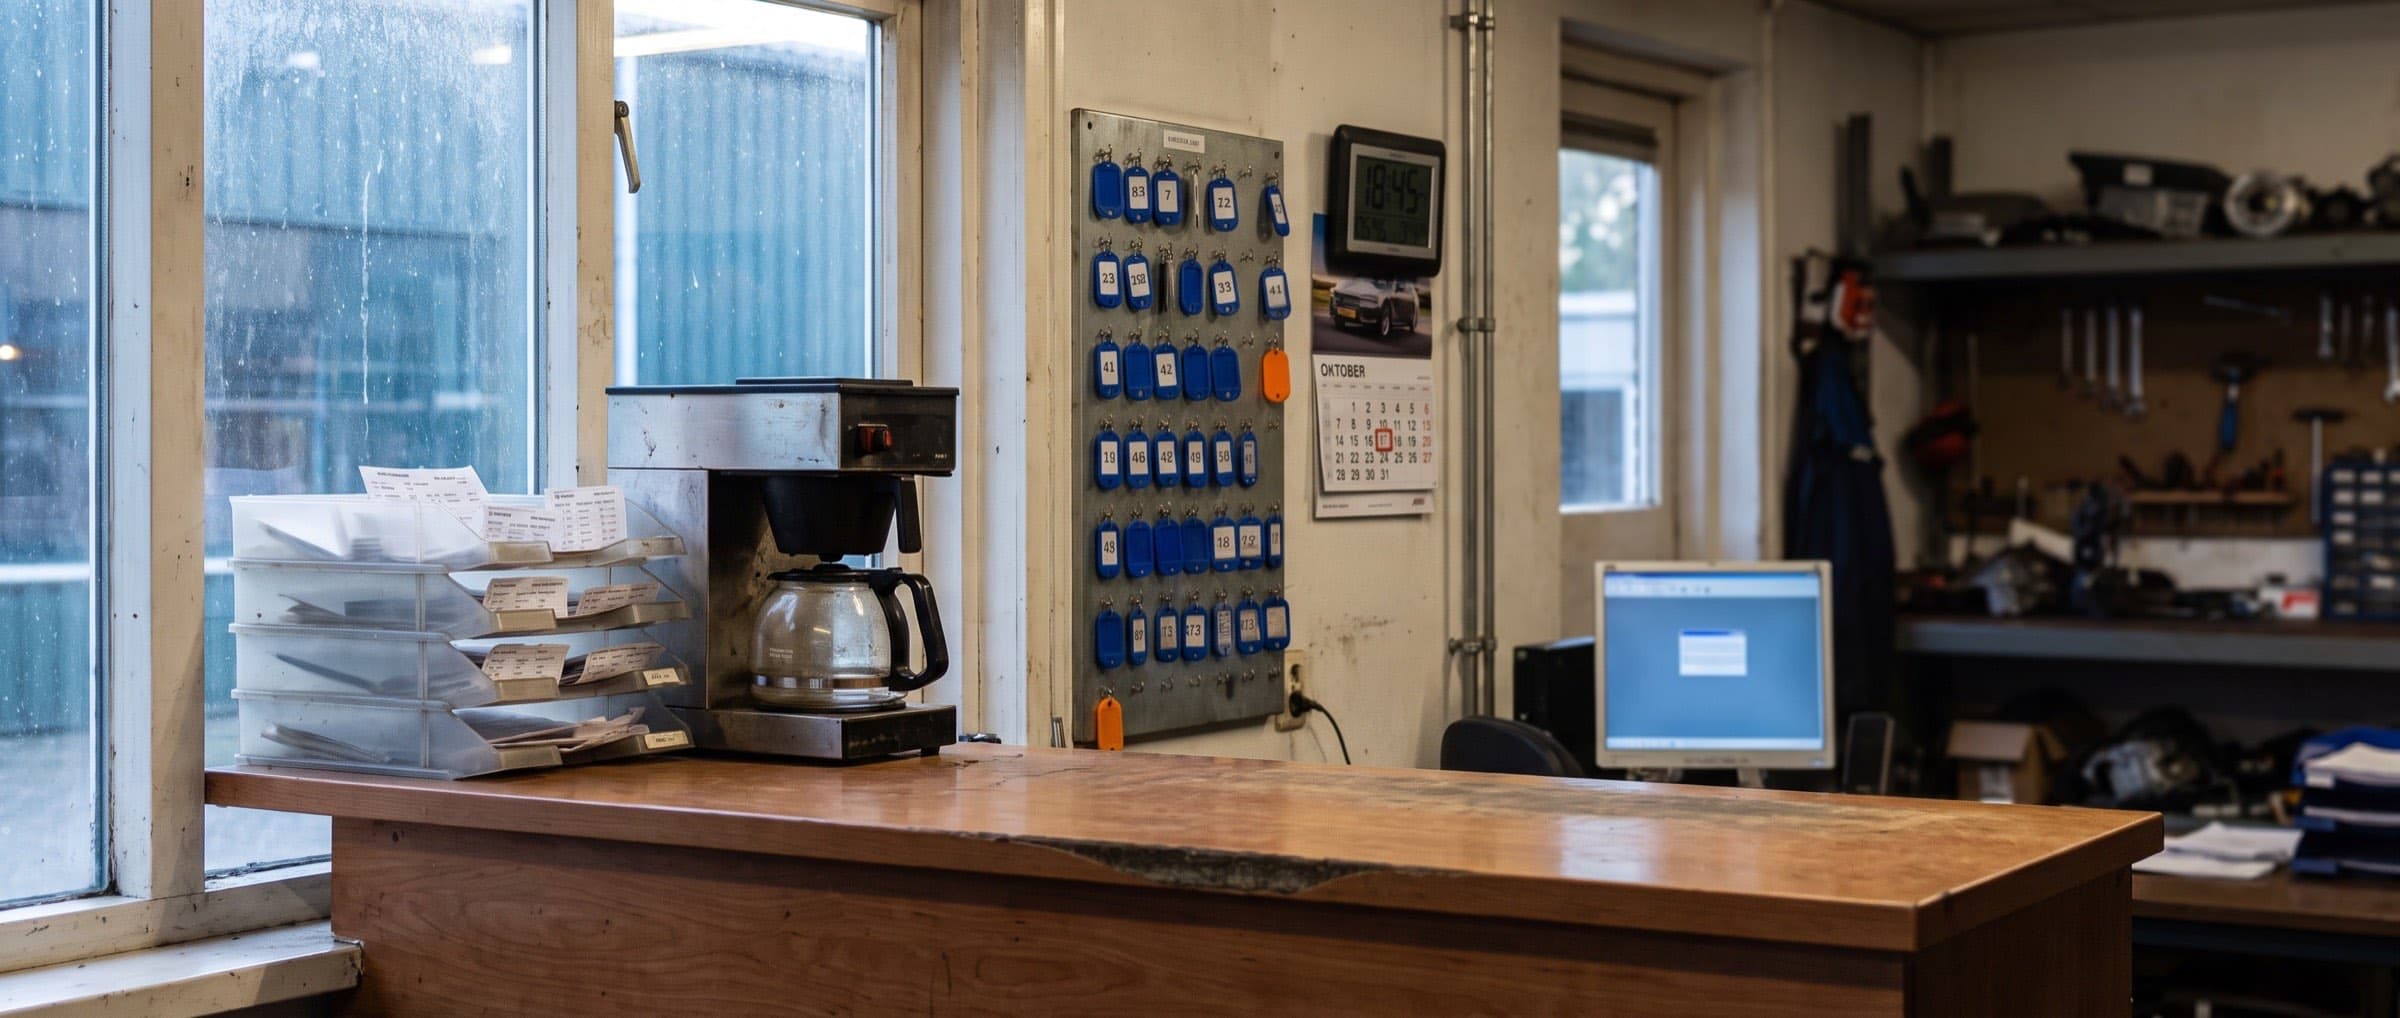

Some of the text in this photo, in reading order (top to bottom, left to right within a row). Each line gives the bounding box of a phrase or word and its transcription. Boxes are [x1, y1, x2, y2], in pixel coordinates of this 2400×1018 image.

[1131, 185, 1146, 198] 83
[1365, 163, 1419, 215] 18:45
[1102, 272, 1116, 285] 23
[1217, 281, 1232, 294] 33
[1268, 284, 1283, 295] 41
[1103, 361, 1116, 373] 41
[1160, 363, 1173, 376] 42
[1320, 363, 1366, 378] OKTOBER
[1394, 420, 1401, 431] 11
[1407, 420, 1416, 431] 12
[1335, 435, 1344, 446] 14
[1350, 435, 1359, 446] 15
[1364, 435, 1373, 447] 16
[1407, 436, 1416, 447] 19
[1103, 451, 1116, 463] 19
[1131, 451, 1146, 463] 46
[1190, 452, 1201, 463] 49
[1335, 452, 1432, 464] 21 22 23 24 25 26 27
[1336, 469, 1389, 481] 28 29 30 31
[1217, 536, 1230, 549] 18
